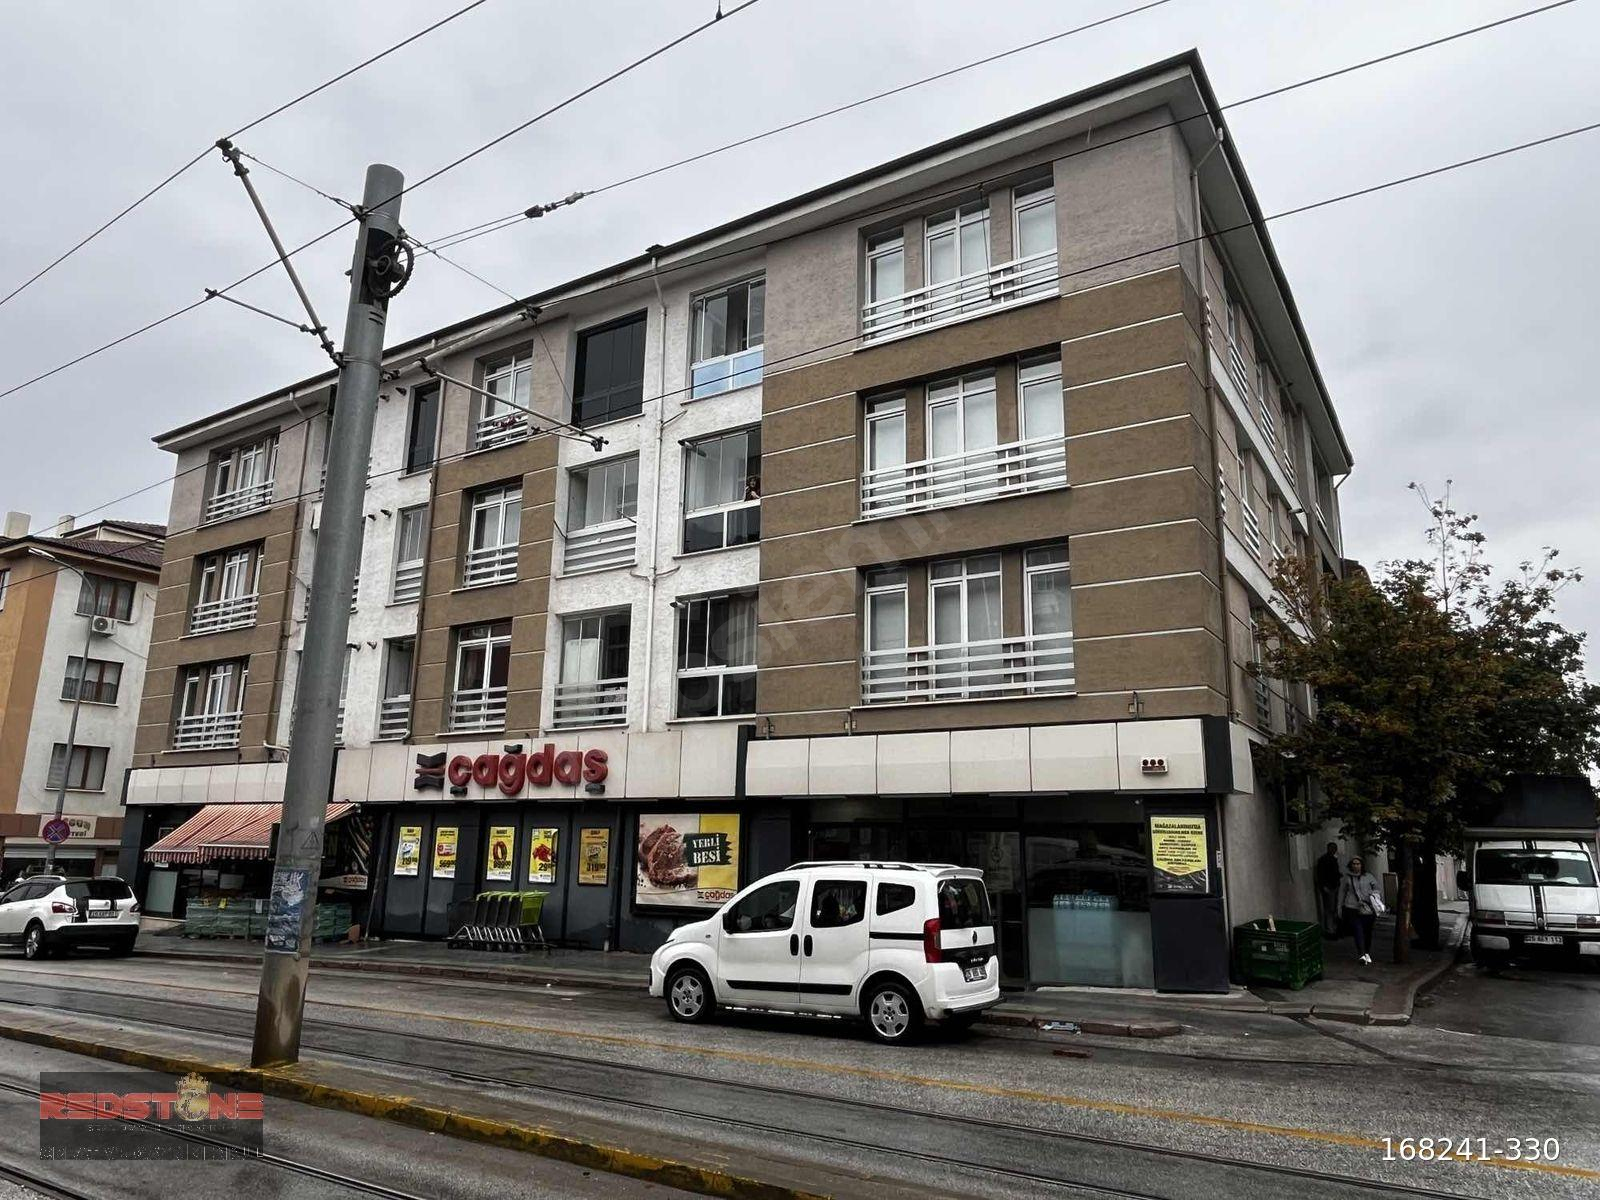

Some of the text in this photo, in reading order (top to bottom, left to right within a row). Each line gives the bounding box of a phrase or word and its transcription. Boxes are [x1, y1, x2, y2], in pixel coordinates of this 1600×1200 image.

[448, 743, 609, 796] çağdaş
[692, 834, 720, 848] YERLİ
[693, 847, 721, 864] BESİ
